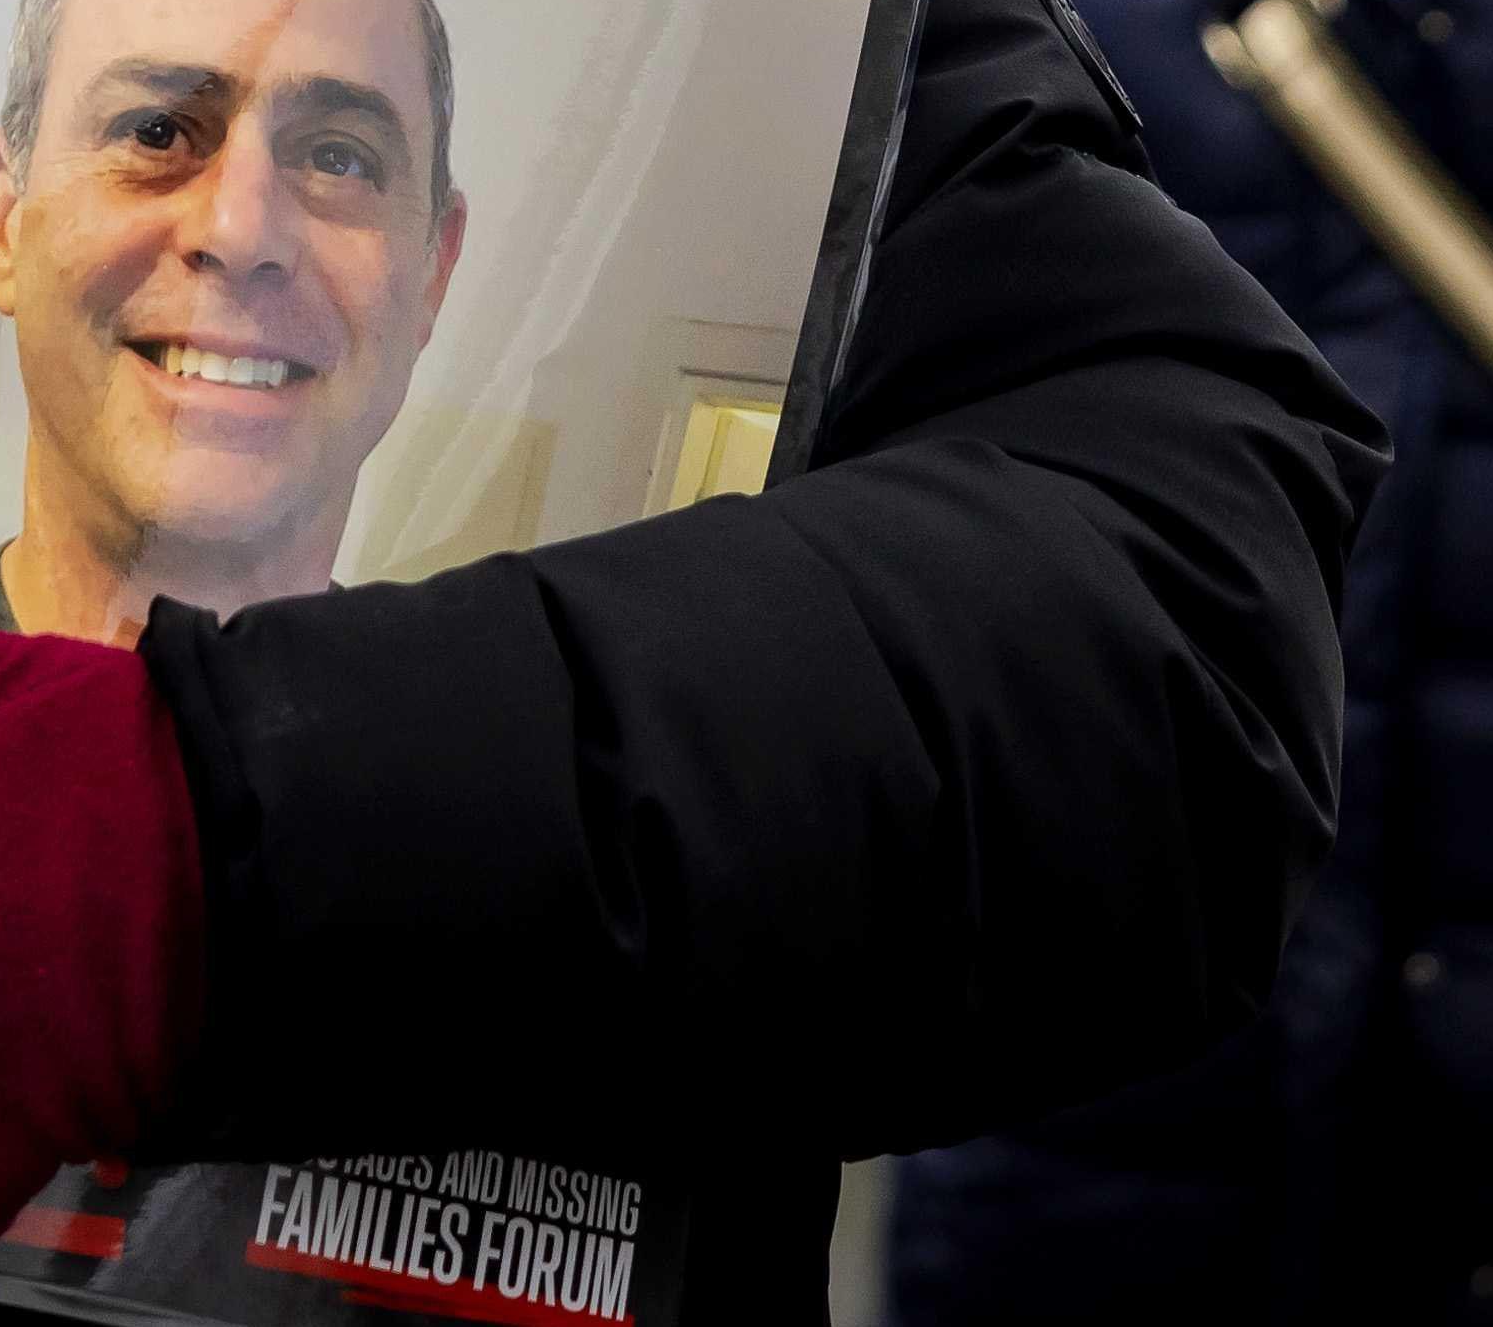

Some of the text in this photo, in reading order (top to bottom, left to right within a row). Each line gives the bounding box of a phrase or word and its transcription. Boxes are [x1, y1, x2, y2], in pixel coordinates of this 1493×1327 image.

[253, 1163, 636, 1322] FAMILIES FORUM
[438, 1148, 504, 1205] AND
[507, 1156, 642, 1237] MISSING
